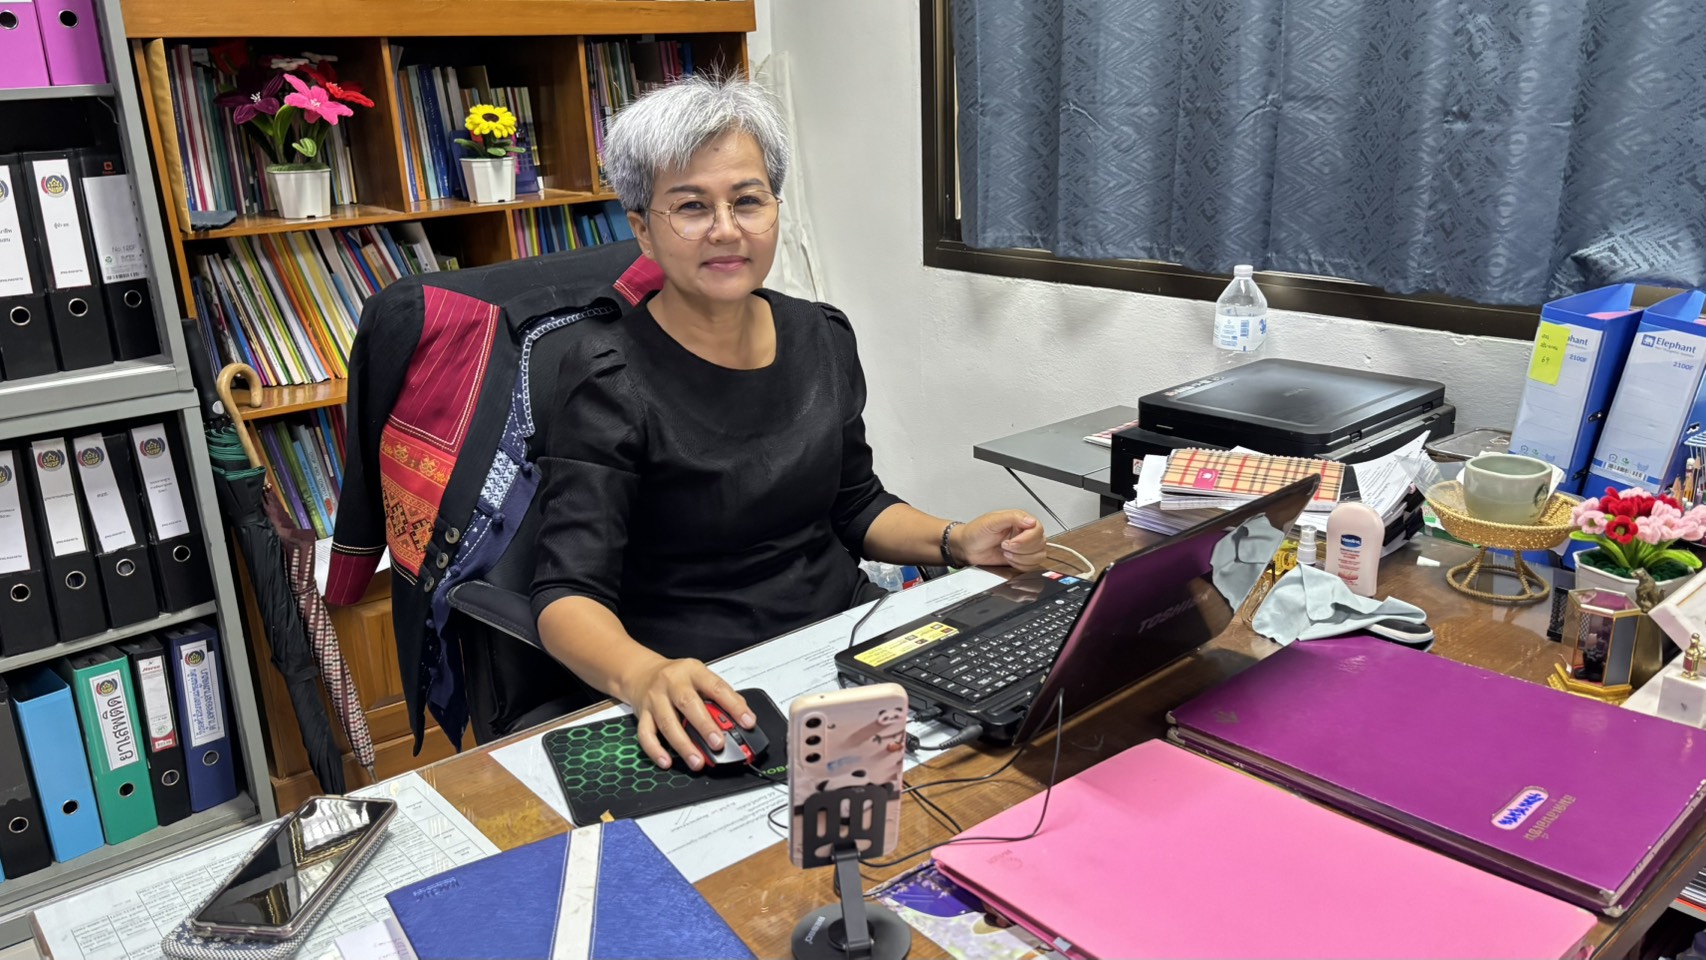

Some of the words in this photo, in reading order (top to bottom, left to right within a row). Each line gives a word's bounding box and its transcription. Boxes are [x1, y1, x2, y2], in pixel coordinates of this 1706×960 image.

[1656, 337, 1696, 353] Elephant
[1138, 587, 1211, 633] TOSHIBA
[102, 695, 134, 761] ยาเสพติด
